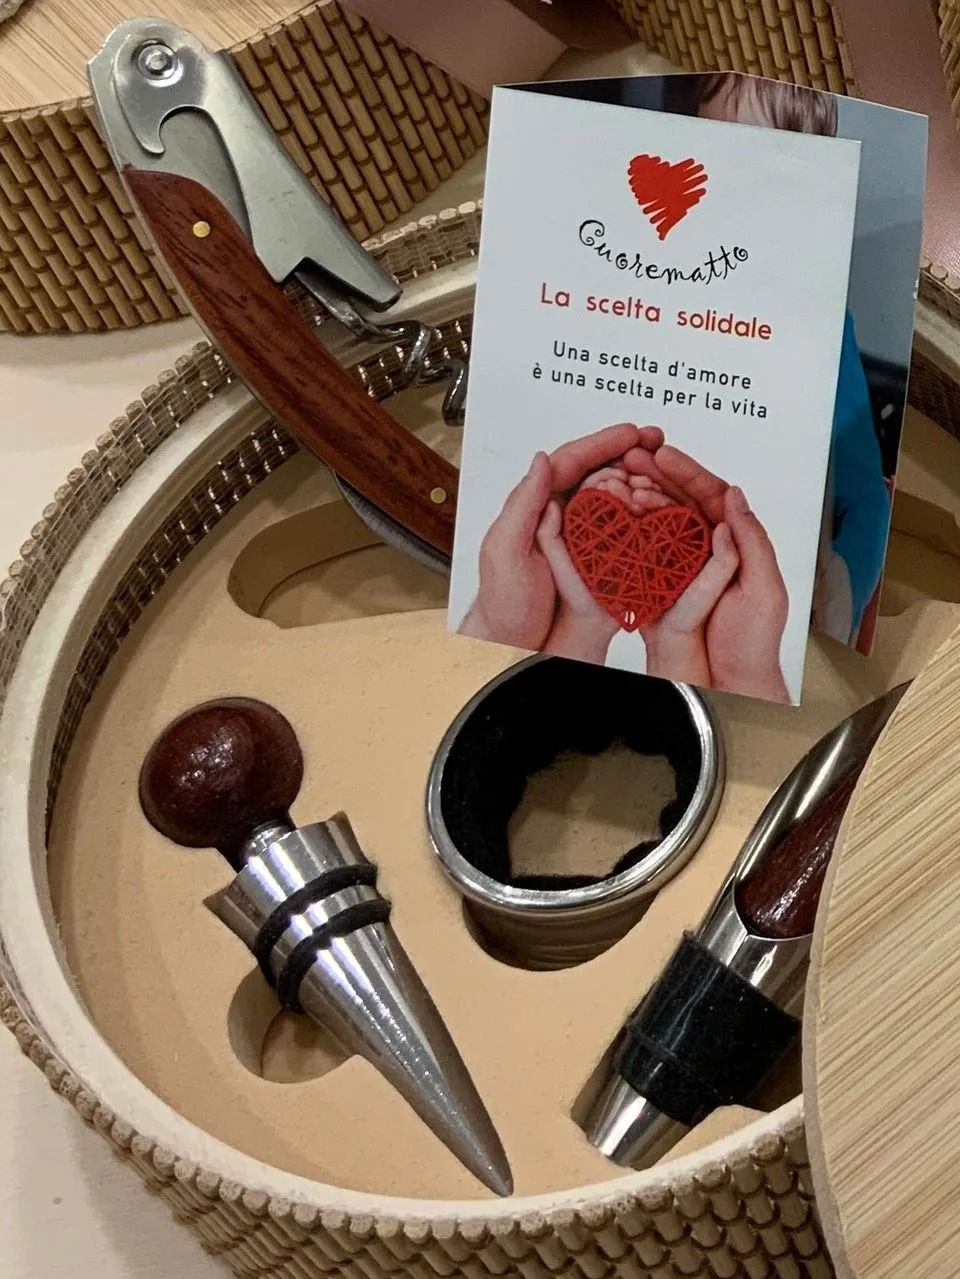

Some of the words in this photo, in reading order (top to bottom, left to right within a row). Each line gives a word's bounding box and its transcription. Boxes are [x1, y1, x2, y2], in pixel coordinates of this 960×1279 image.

[578, 219, 749, 285] Cuorematto
[540, 282, 570, 307] La
[586, 295, 661, 323] scelta
[677, 309, 772, 340] solidale
[532, 362, 543, 379] è
[551, 369, 586, 387] una
[594, 376, 654, 399] scelta
[663, 387, 697, 405] per
[705, 392, 722, 410] la
[731, 398, 768, 418] vita
[553, 340, 590, 362] Una
[598, 350, 659, 374] scelta
[668, 361, 752, 389] d'amore
